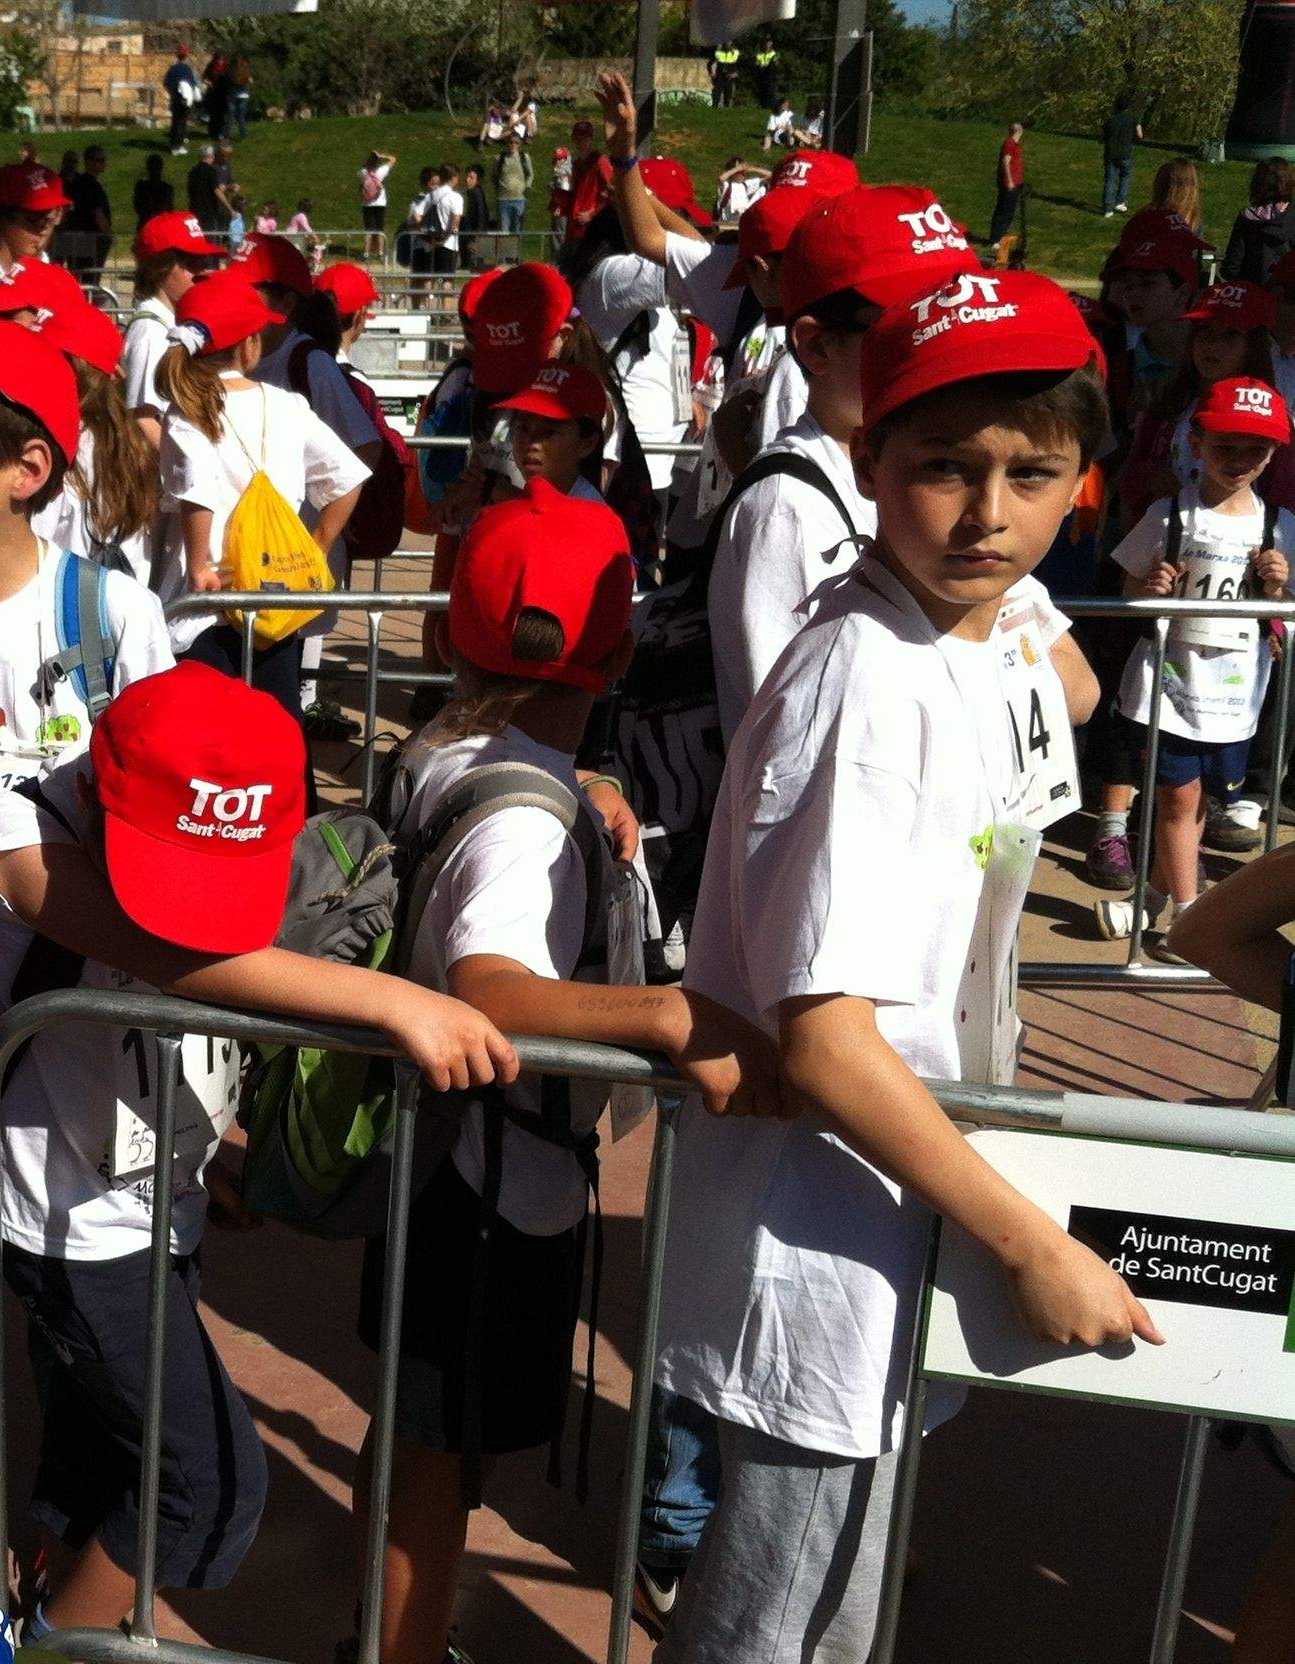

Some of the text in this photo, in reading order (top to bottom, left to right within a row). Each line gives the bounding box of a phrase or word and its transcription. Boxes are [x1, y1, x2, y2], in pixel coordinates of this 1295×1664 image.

[897, 203, 960, 238] TO
[911, 303, 1019, 346] Sant Cugat
[1234, 387, 1273, 408] TOT
[189, 778, 273, 822] TOT
[176, 815, 267, 843] Sant Cugat
[1120, 1225, 1272, 1264] Ajuntament
[1108, 1253, 1279, 1295] de SantCugat
